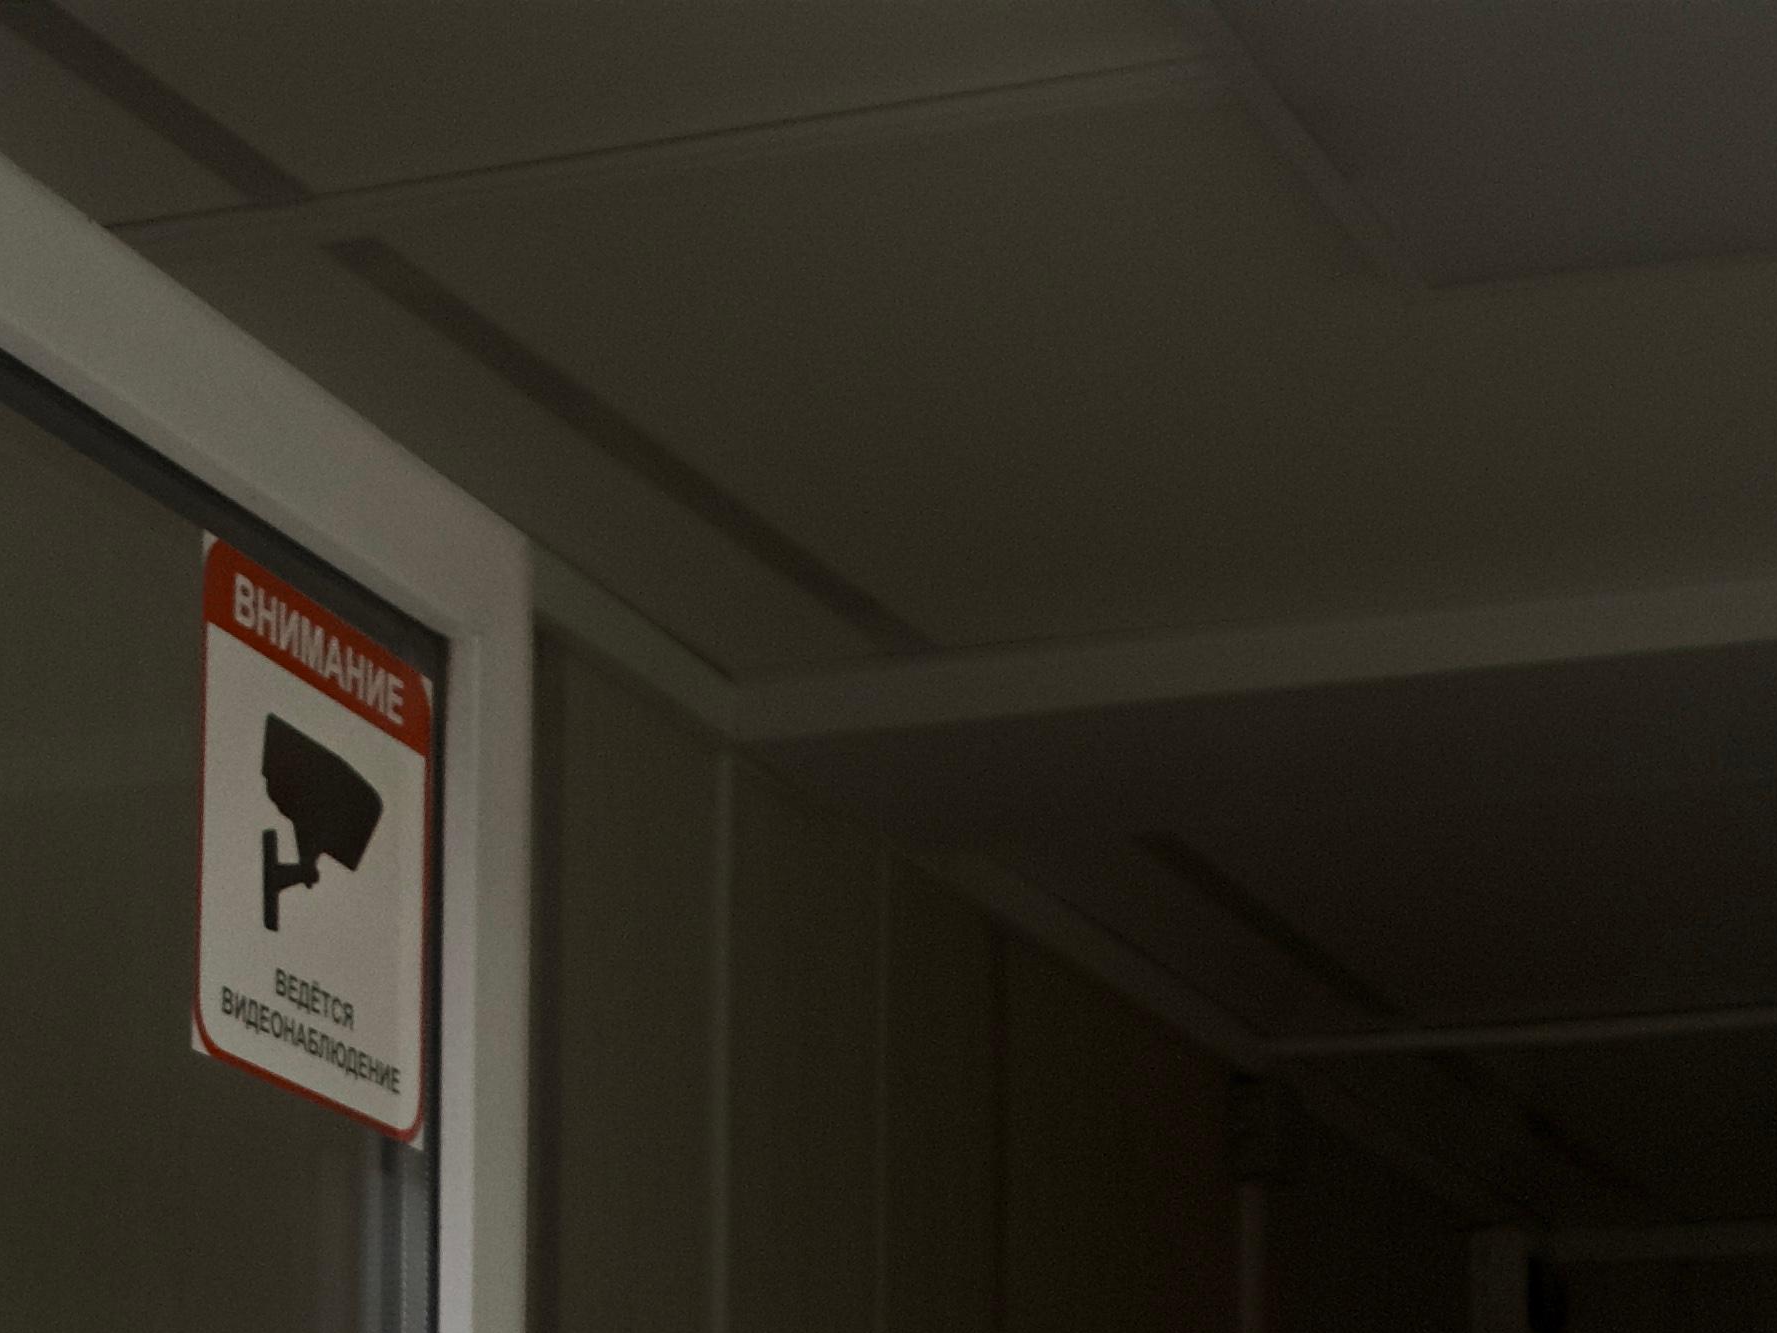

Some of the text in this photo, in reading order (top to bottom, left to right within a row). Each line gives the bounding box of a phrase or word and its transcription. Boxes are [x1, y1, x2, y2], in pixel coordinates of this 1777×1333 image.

[234, 572, 405, 726] ВНИМАНИЕ
[221, 985, 401, 1094] ВИДЕОНАБЛЮДЕНИЕ
[275, 967, 354, 1031] ВЕДЁТСЯ
